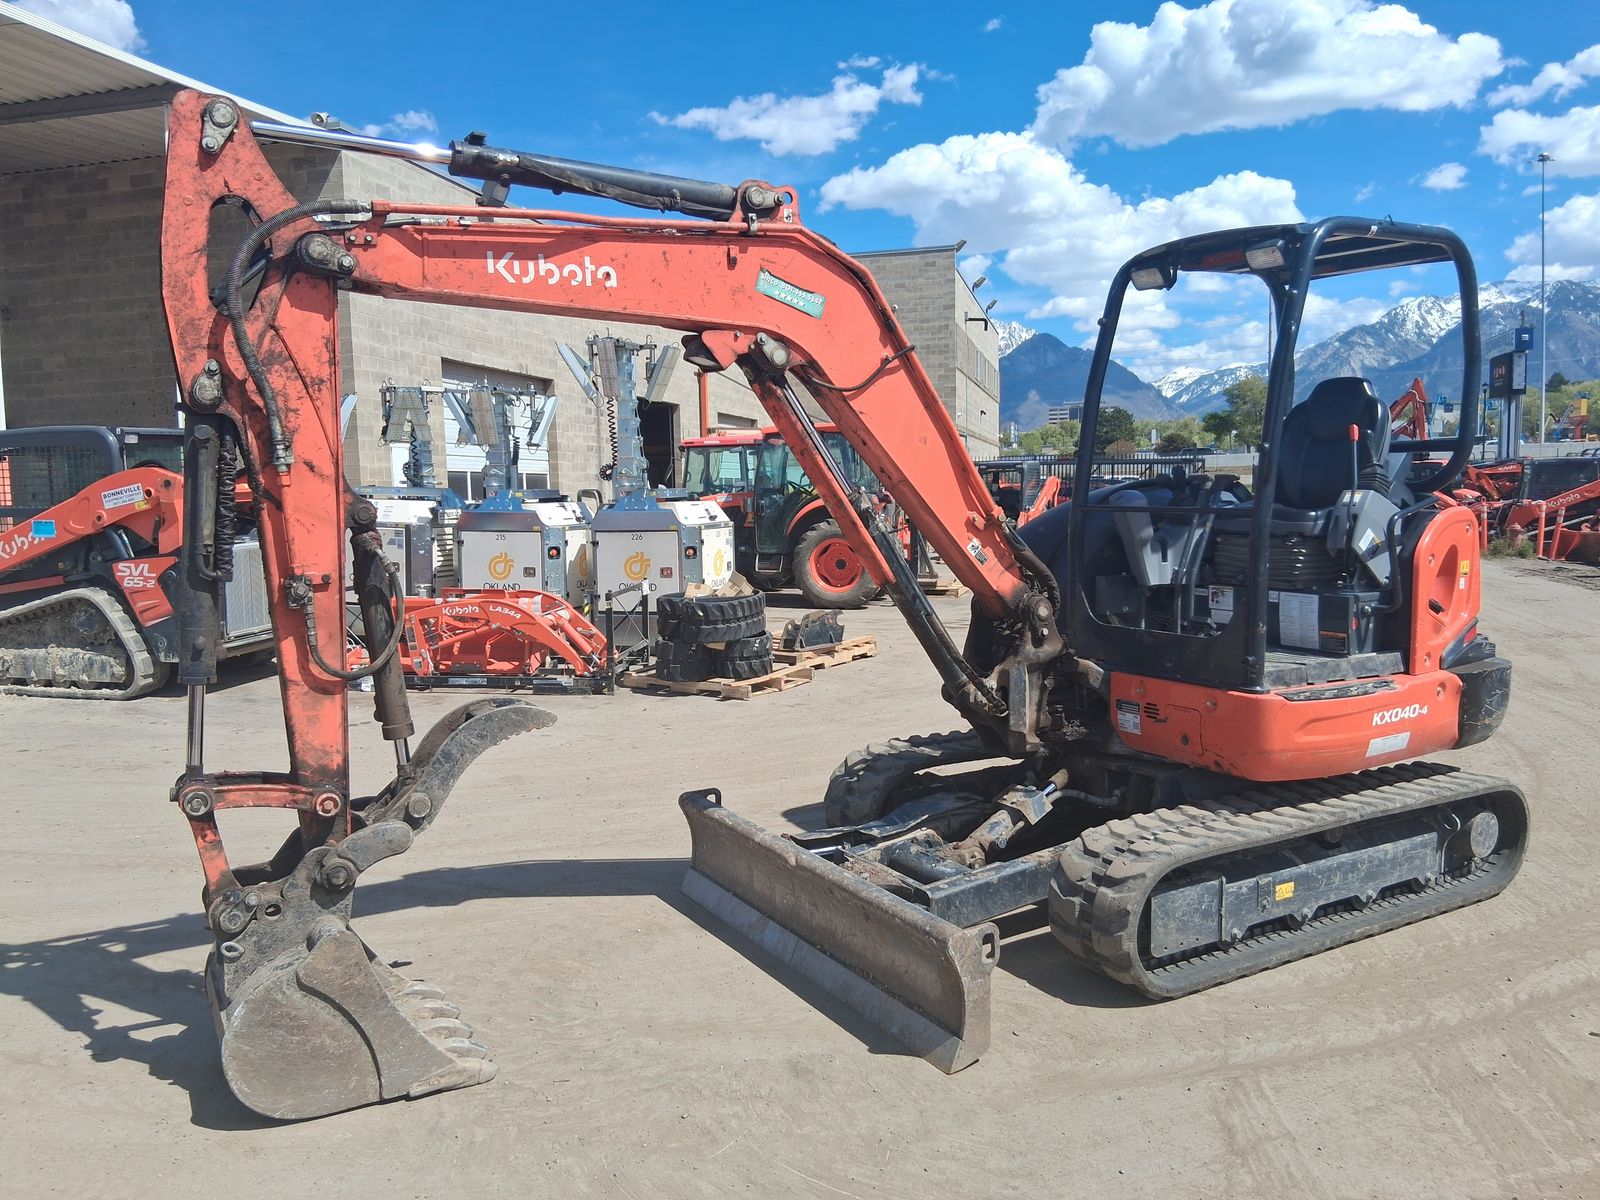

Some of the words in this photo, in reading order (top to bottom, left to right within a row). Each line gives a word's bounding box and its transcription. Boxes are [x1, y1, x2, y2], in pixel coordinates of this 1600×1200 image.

[486, 250, 618, 288] Kubota
[102, 485, 142, 500] BONNEVILLE
[1547, 493, 1581, 508] Kubota
[495, 533, 507, 541] 215
[631, 533, 643, 541] 226
[116, 562, 157, 577] SVL
[123, 576, 156, 588] 65-2
[442, 604, 480, 616] Kubota
[489, 604, 522, 619] LA344
[1371, 703, 1428, 727] KX040-4
